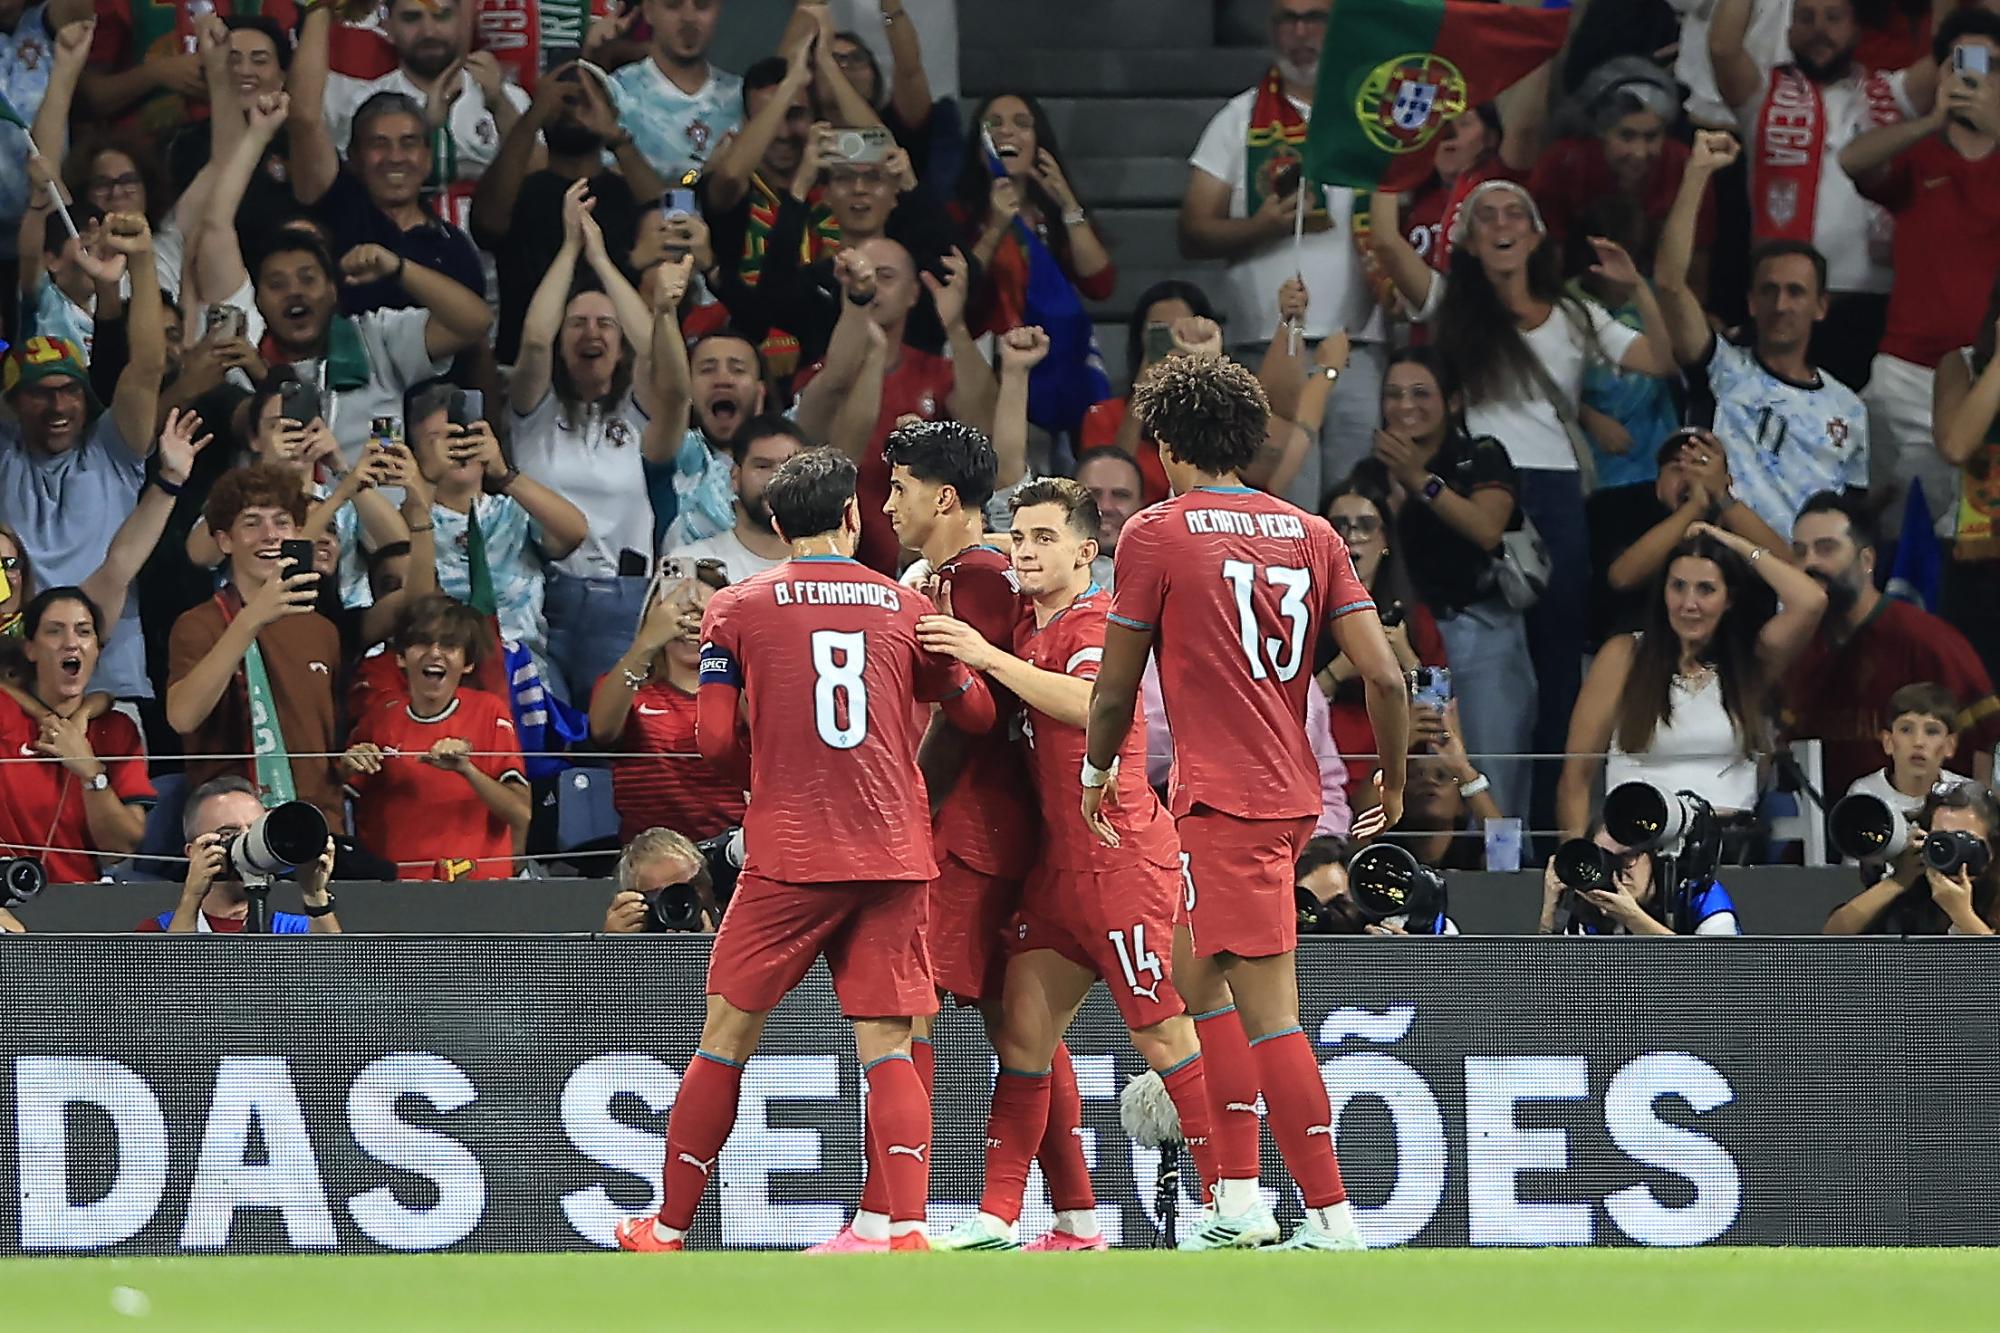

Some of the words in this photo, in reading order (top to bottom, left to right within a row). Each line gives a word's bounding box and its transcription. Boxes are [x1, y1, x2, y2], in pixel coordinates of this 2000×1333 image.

[1184, 509, 1255, 537] RENATO
[1255, 513, 1306, 539] VEIGA
[1222, 559, 1312, 683] 13
[811, 628, 868, 750] 8
[1108, 922, 1163, 988] 14
[14, 1051, 486, 1250] DAS
[559, 1005, 1742, 1249] SEÕES
